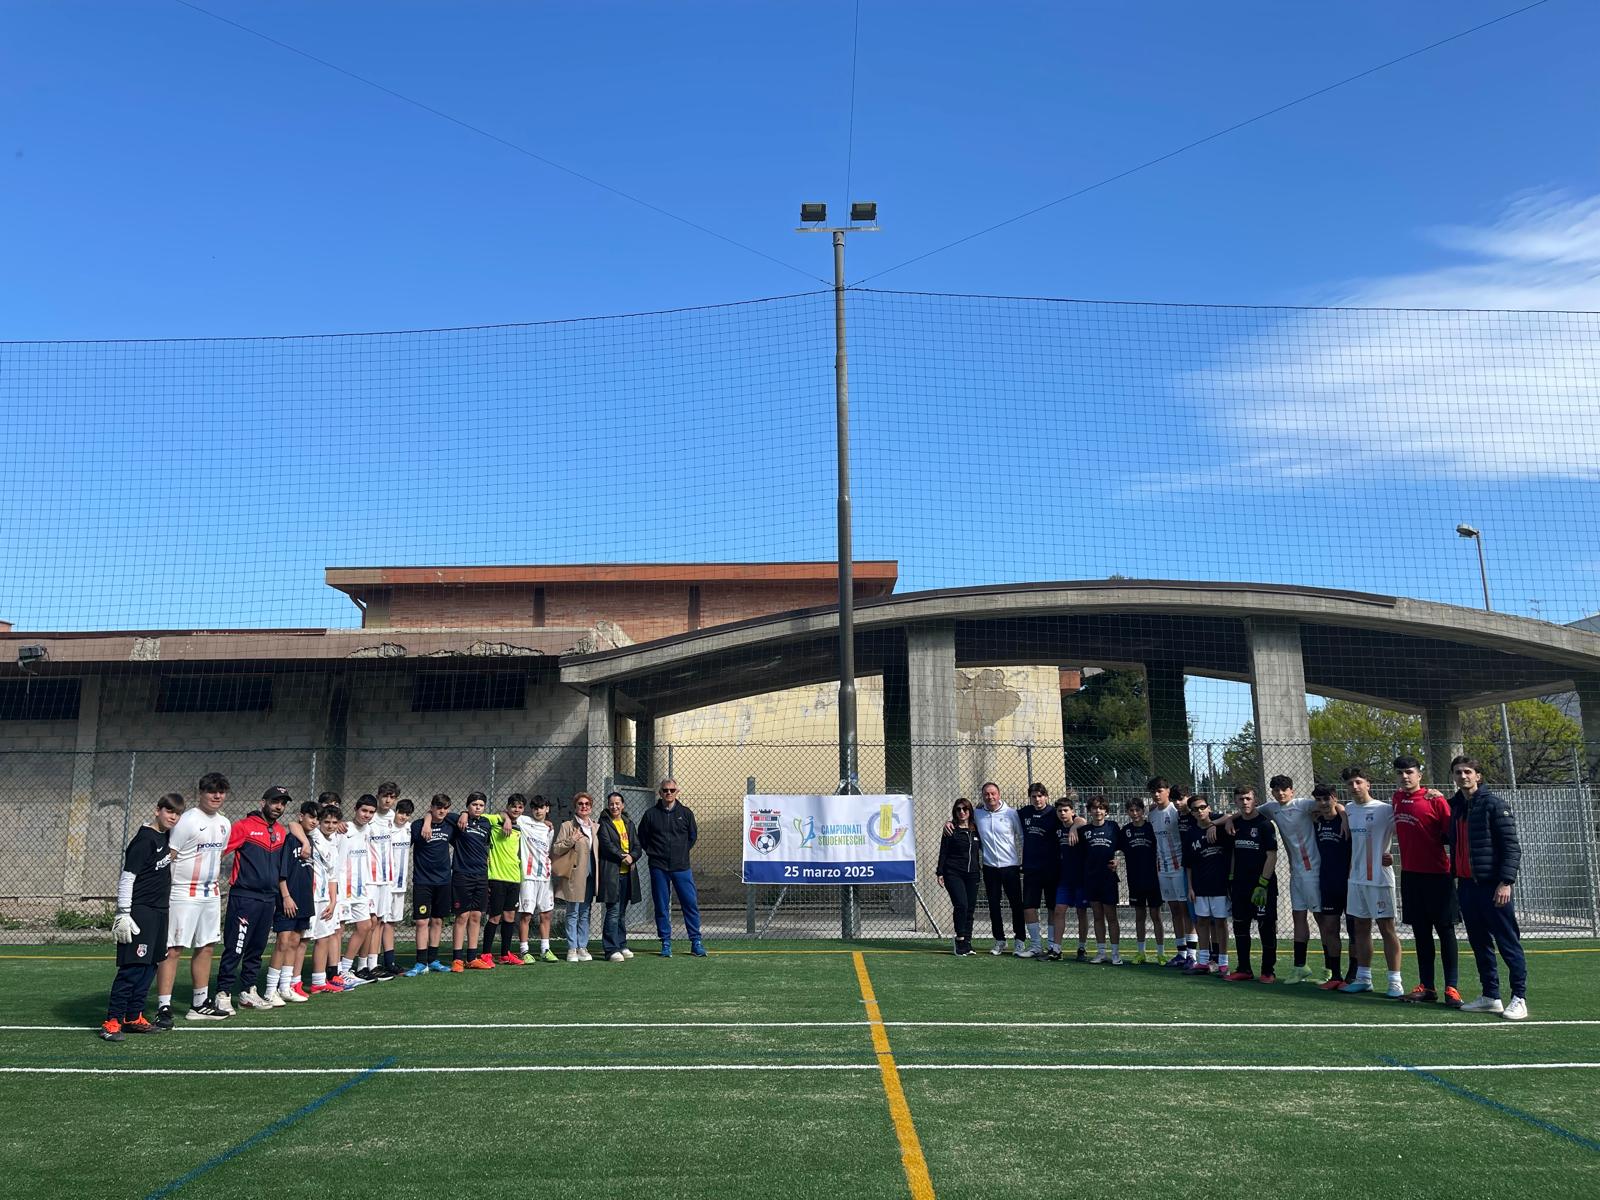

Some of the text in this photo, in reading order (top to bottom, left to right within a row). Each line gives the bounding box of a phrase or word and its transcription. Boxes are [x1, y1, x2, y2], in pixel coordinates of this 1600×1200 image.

[821, 824, 862, 835] CAMPIONATI
[817, 835, 866, 847] STUDENTESCHI
[1191, 839, 1201, 851] 14
[784, 866, 875, 878] 25 marzo 2025
[235, 924, 248, 955] Zeus
